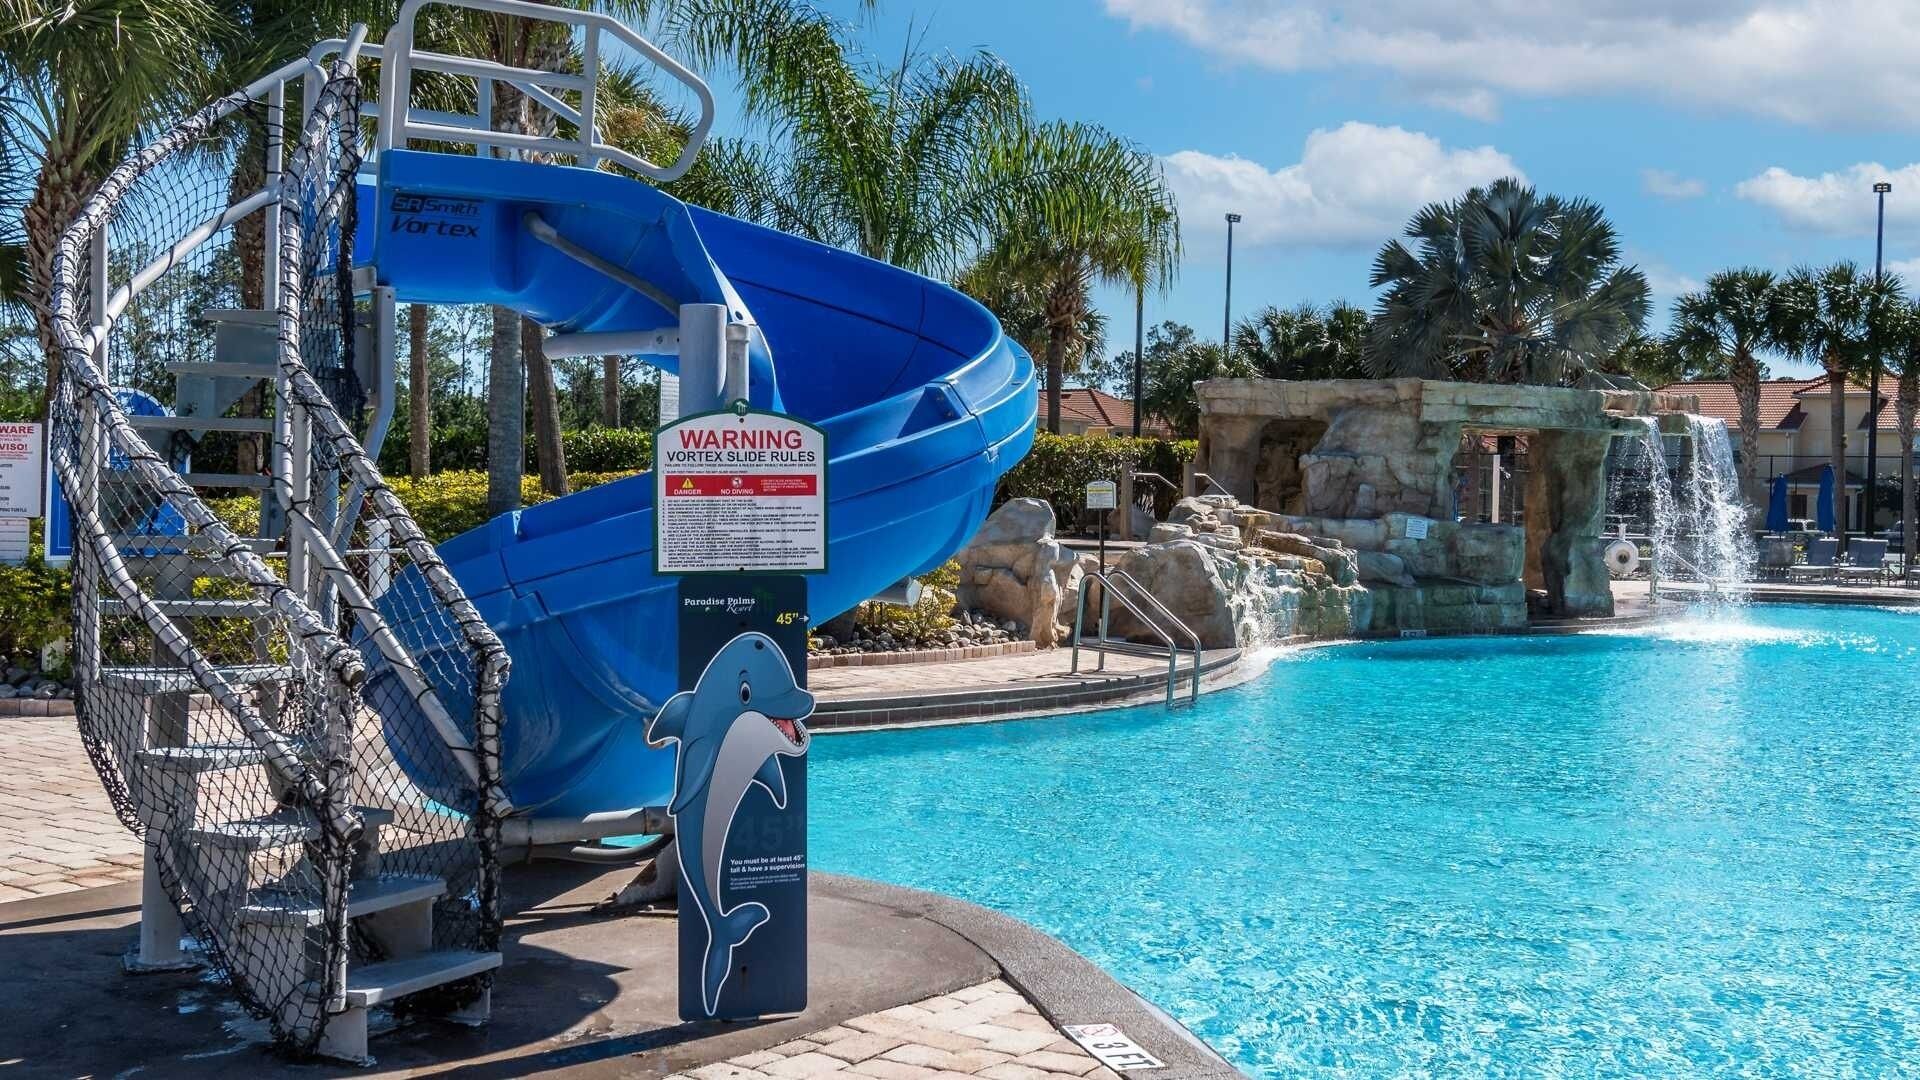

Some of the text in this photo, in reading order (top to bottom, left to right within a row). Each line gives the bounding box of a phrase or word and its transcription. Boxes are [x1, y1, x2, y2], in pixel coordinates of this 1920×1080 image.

[391, 214, 480, 238] Vortex
[679, 429, 803, 450] WARNING
[667, 451, 816, 462] VORTEX SLIDE RULES
[684, 597, 756, 606] Paradise Palms
[726, 602, 753, 615] Resort
[770, 863, 805, 871] supervision
[1092, 1041, 1129, 1050] 3
